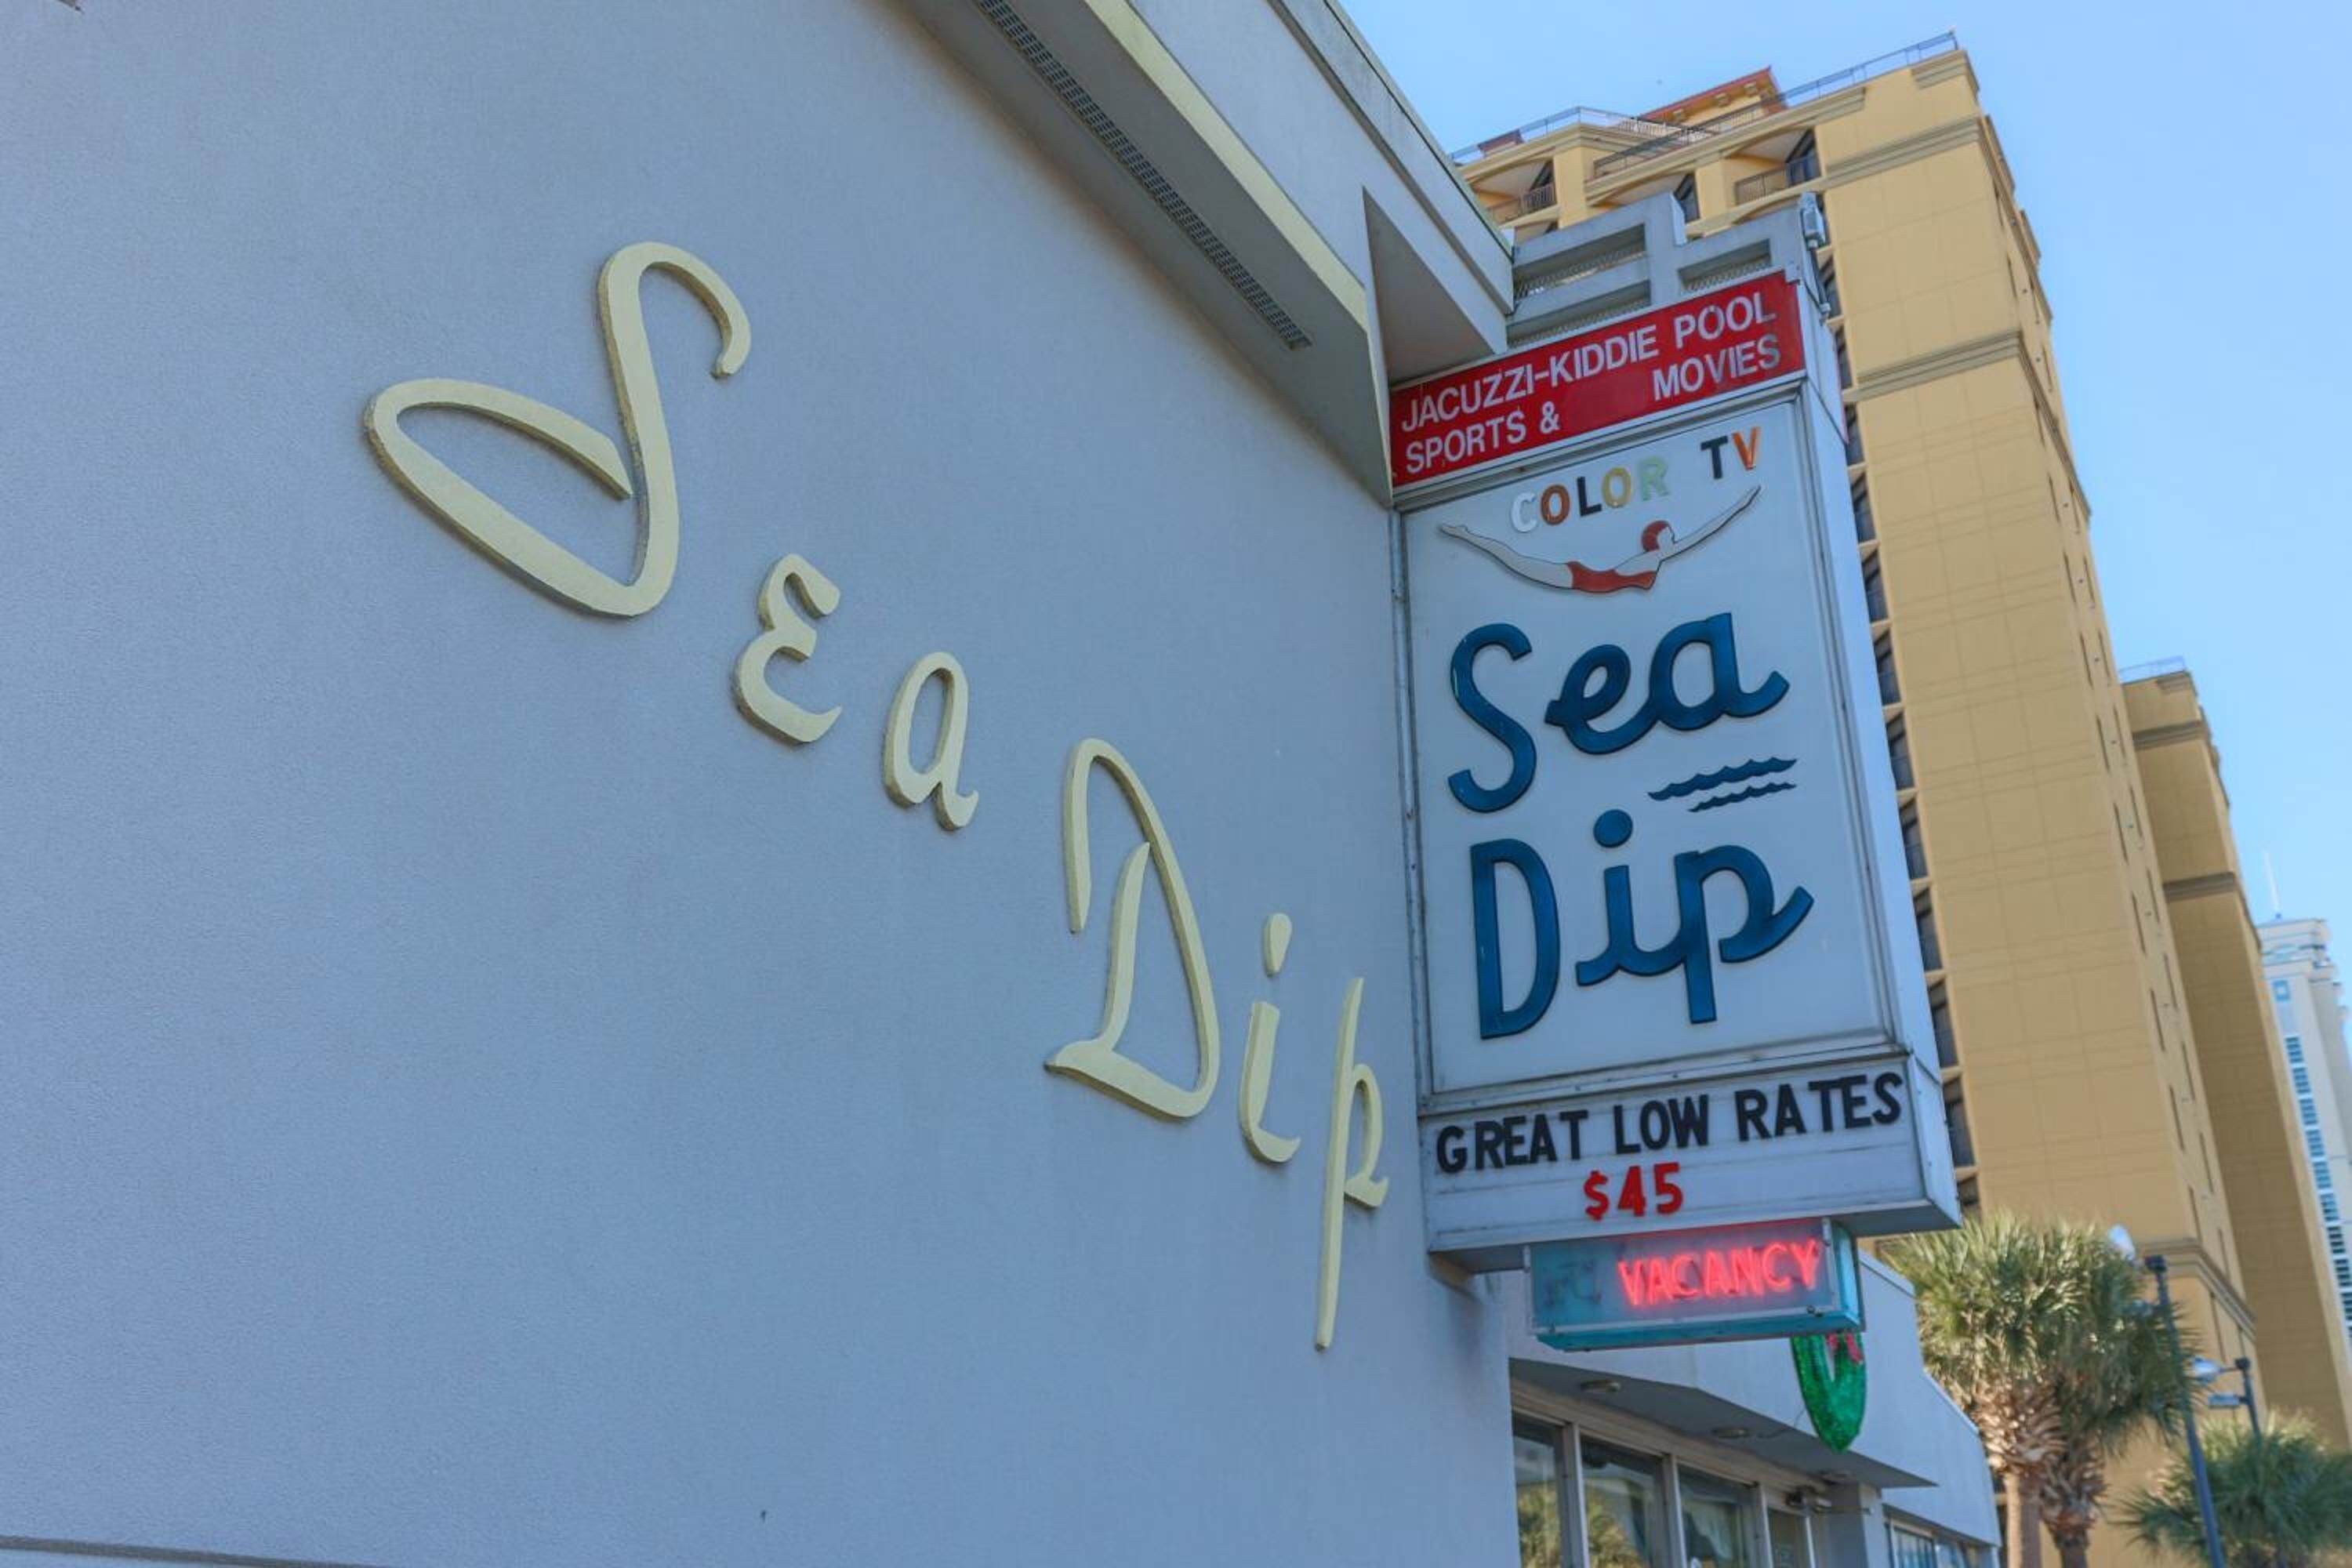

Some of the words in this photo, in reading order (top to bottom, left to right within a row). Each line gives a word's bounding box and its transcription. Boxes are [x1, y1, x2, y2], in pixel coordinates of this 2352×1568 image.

[1402, 325, 1658, 432] JACUZZI-KIDDIE
[1674, 292, 1777, 347] POOL
[1405, 406, 1526, 475] SPORTS
[1539, 401, 1561, 435] &
[1653, 333, 1780, 401] MOVIES
[1511, 455, 1669, 534] COLOR
[1700, 426, 1761, 480] TV
[1447, 612, 1790, 813] Sea
[365, 241, 979, 829] Sea
[1044, 738, 1389, 1350] Dip
[1469, 808, 1815, 1040] Dip
[1436, 1109, 1589, 1174] GREAT
[1613, 1094, 1709, 1155] LOW
[1734, 1072, 1904, 1142] RATES
[1583, 1162, 1684, 1221] $45
[1617, 1237, 1823, 1306] VACANCY
